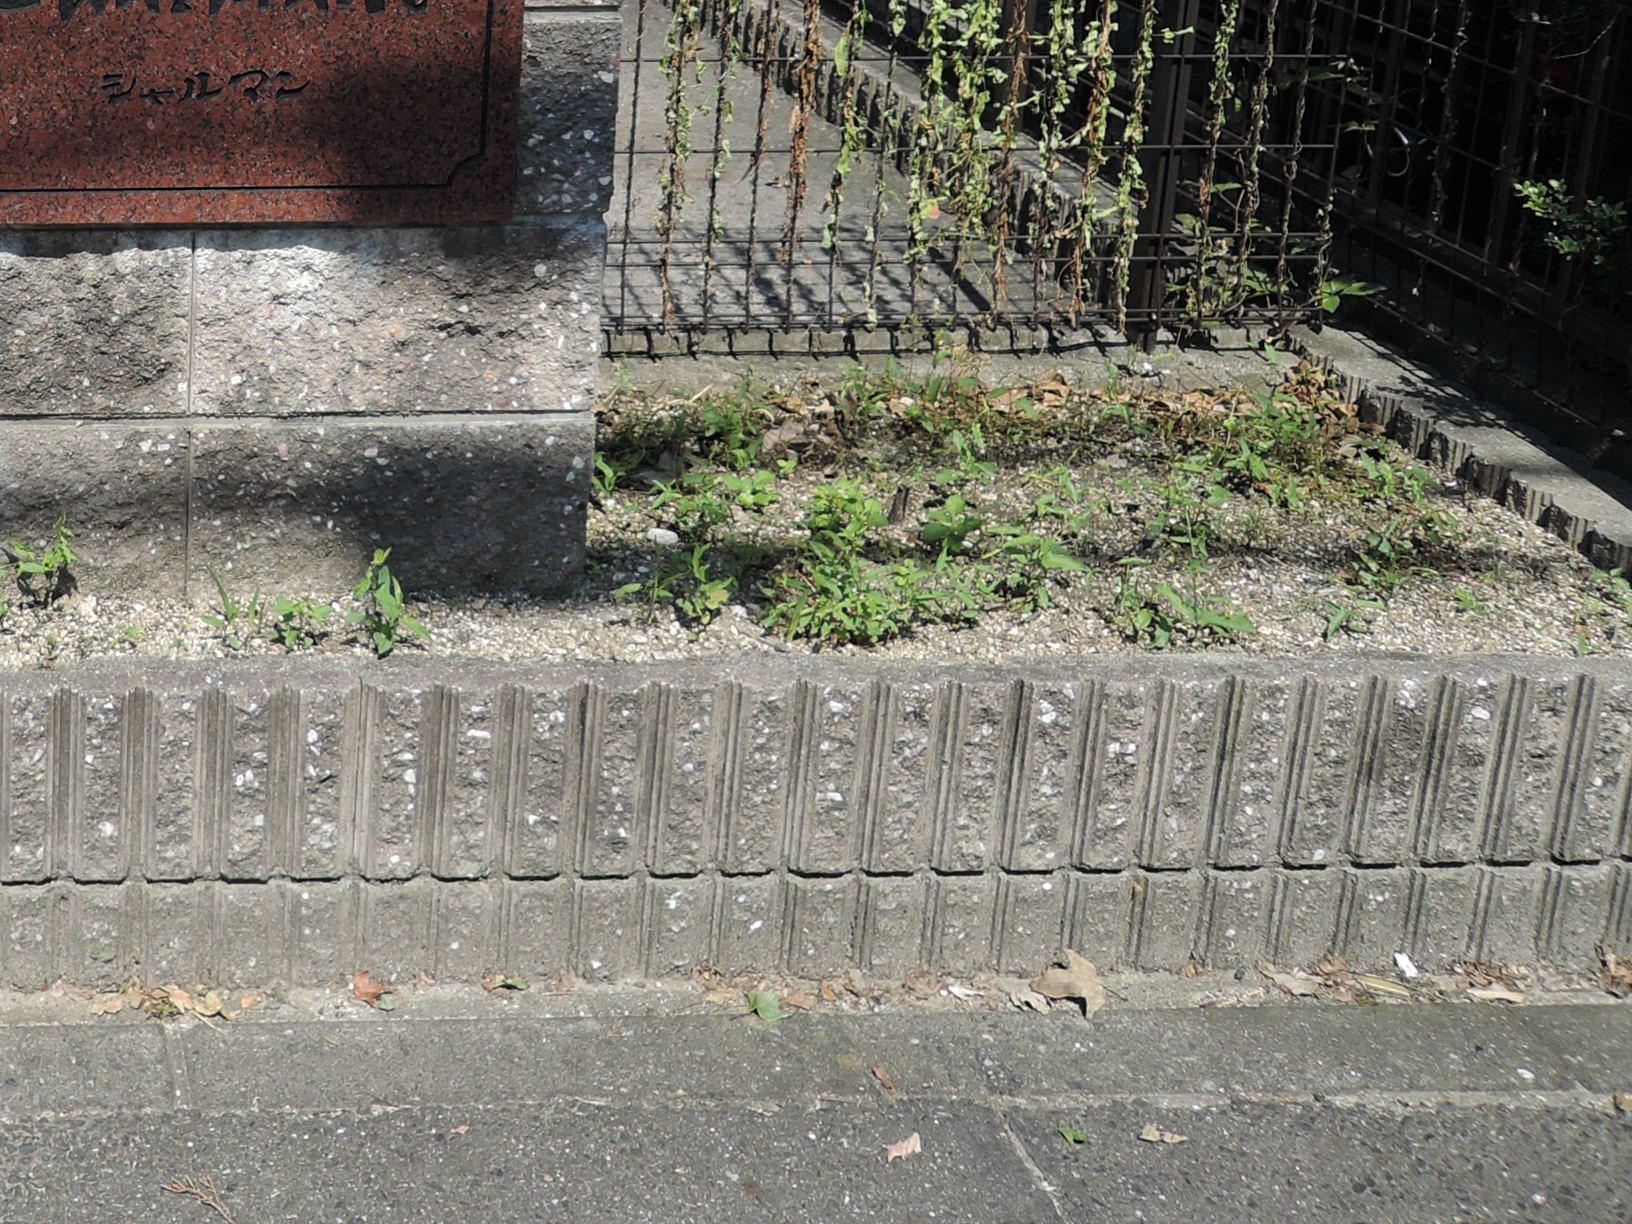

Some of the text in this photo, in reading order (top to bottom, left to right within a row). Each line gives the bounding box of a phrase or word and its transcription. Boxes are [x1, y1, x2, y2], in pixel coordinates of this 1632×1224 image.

[102, 69, 310, 104] シャルマン
